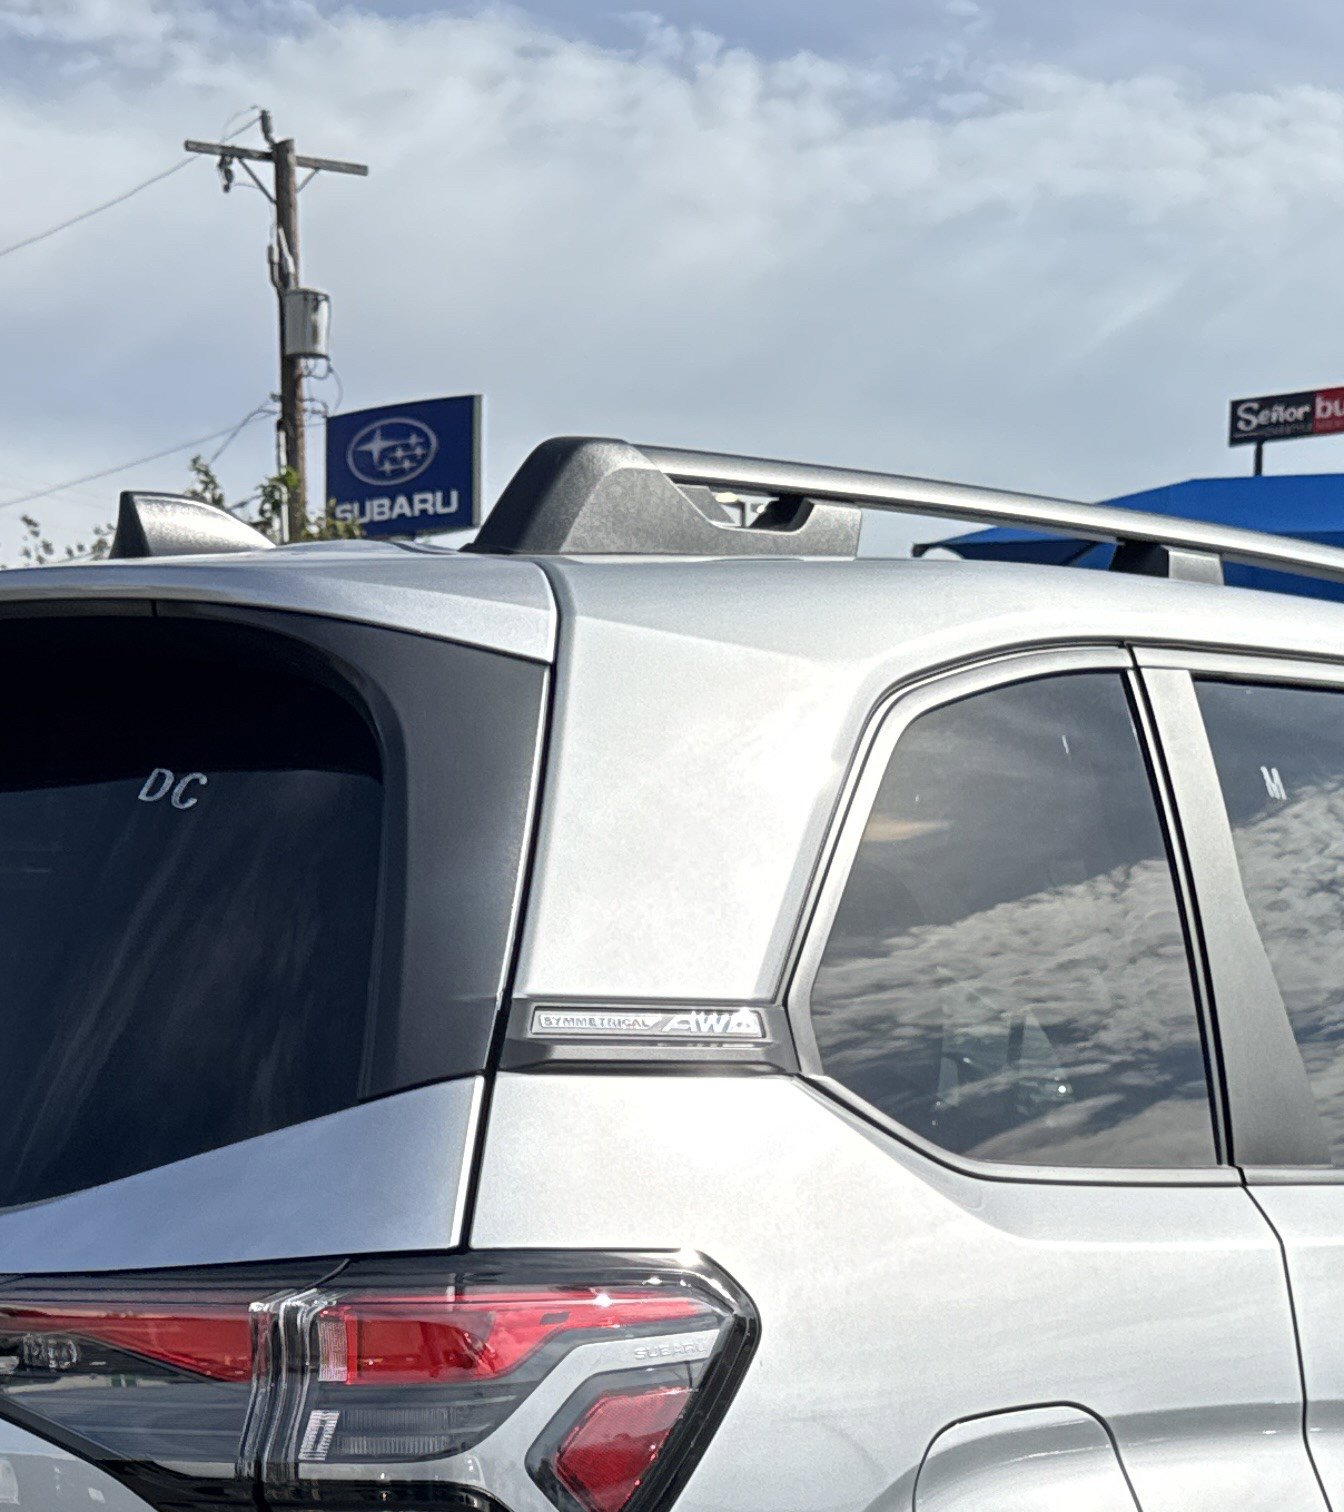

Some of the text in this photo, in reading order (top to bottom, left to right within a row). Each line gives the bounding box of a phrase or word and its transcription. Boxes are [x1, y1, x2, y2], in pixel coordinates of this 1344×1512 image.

[1234, 401, 1310, 431] Señor
[335, 489, 459, 524] SUBARU
[137, 767, 207, 809] DC
[543, 1015, 650, 1029] SYMMETRICAL
